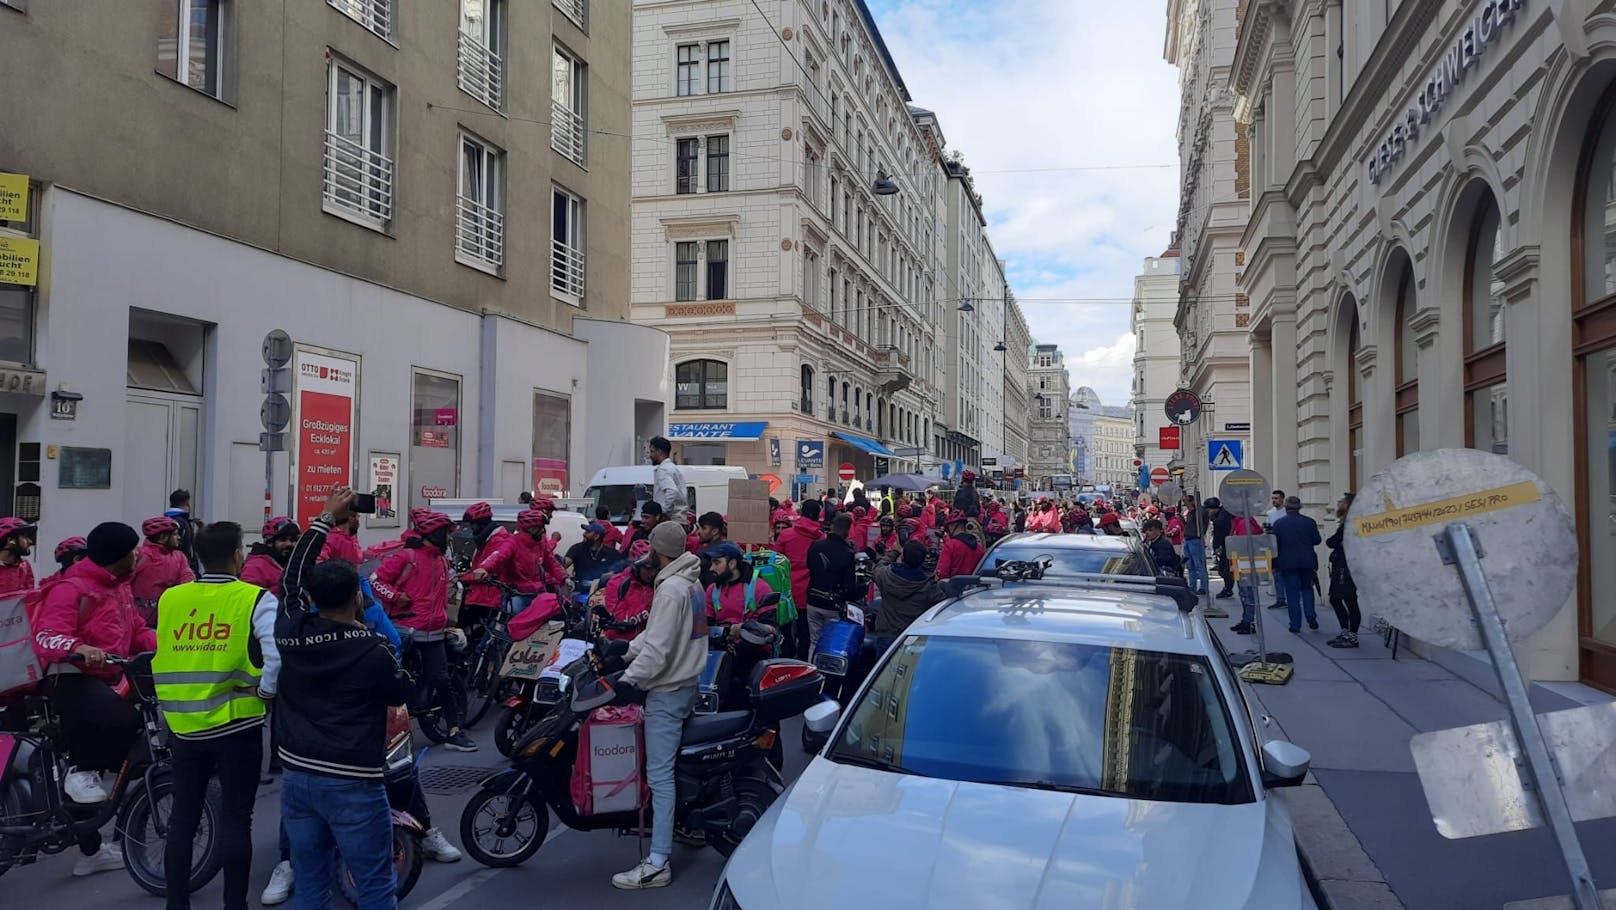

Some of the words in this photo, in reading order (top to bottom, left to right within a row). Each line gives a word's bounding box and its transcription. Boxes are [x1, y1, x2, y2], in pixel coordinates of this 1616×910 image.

[1415, 0, 1522, 126] SCHWEIGE
[0, 254, 30, 263] bilien
[301, 363, 319, 373] OTTO
[56, 402, 71, 413] 10
[303, 418, 348, 433] Großzügiges
[311, 433, 341, 445] Ecklokal
[307, 464, 316, 473] zu
[317, 464, 342, 474] mieten
[422, 485, 447, 498] foodora
[173, 608, 232, 641] vida
[305, 632, 338, 646] ICON
[343, 630, 372, 639] ICON
[172, 642, 228, 652] www.vida.at
[593, 744, 636, 757] foodora
